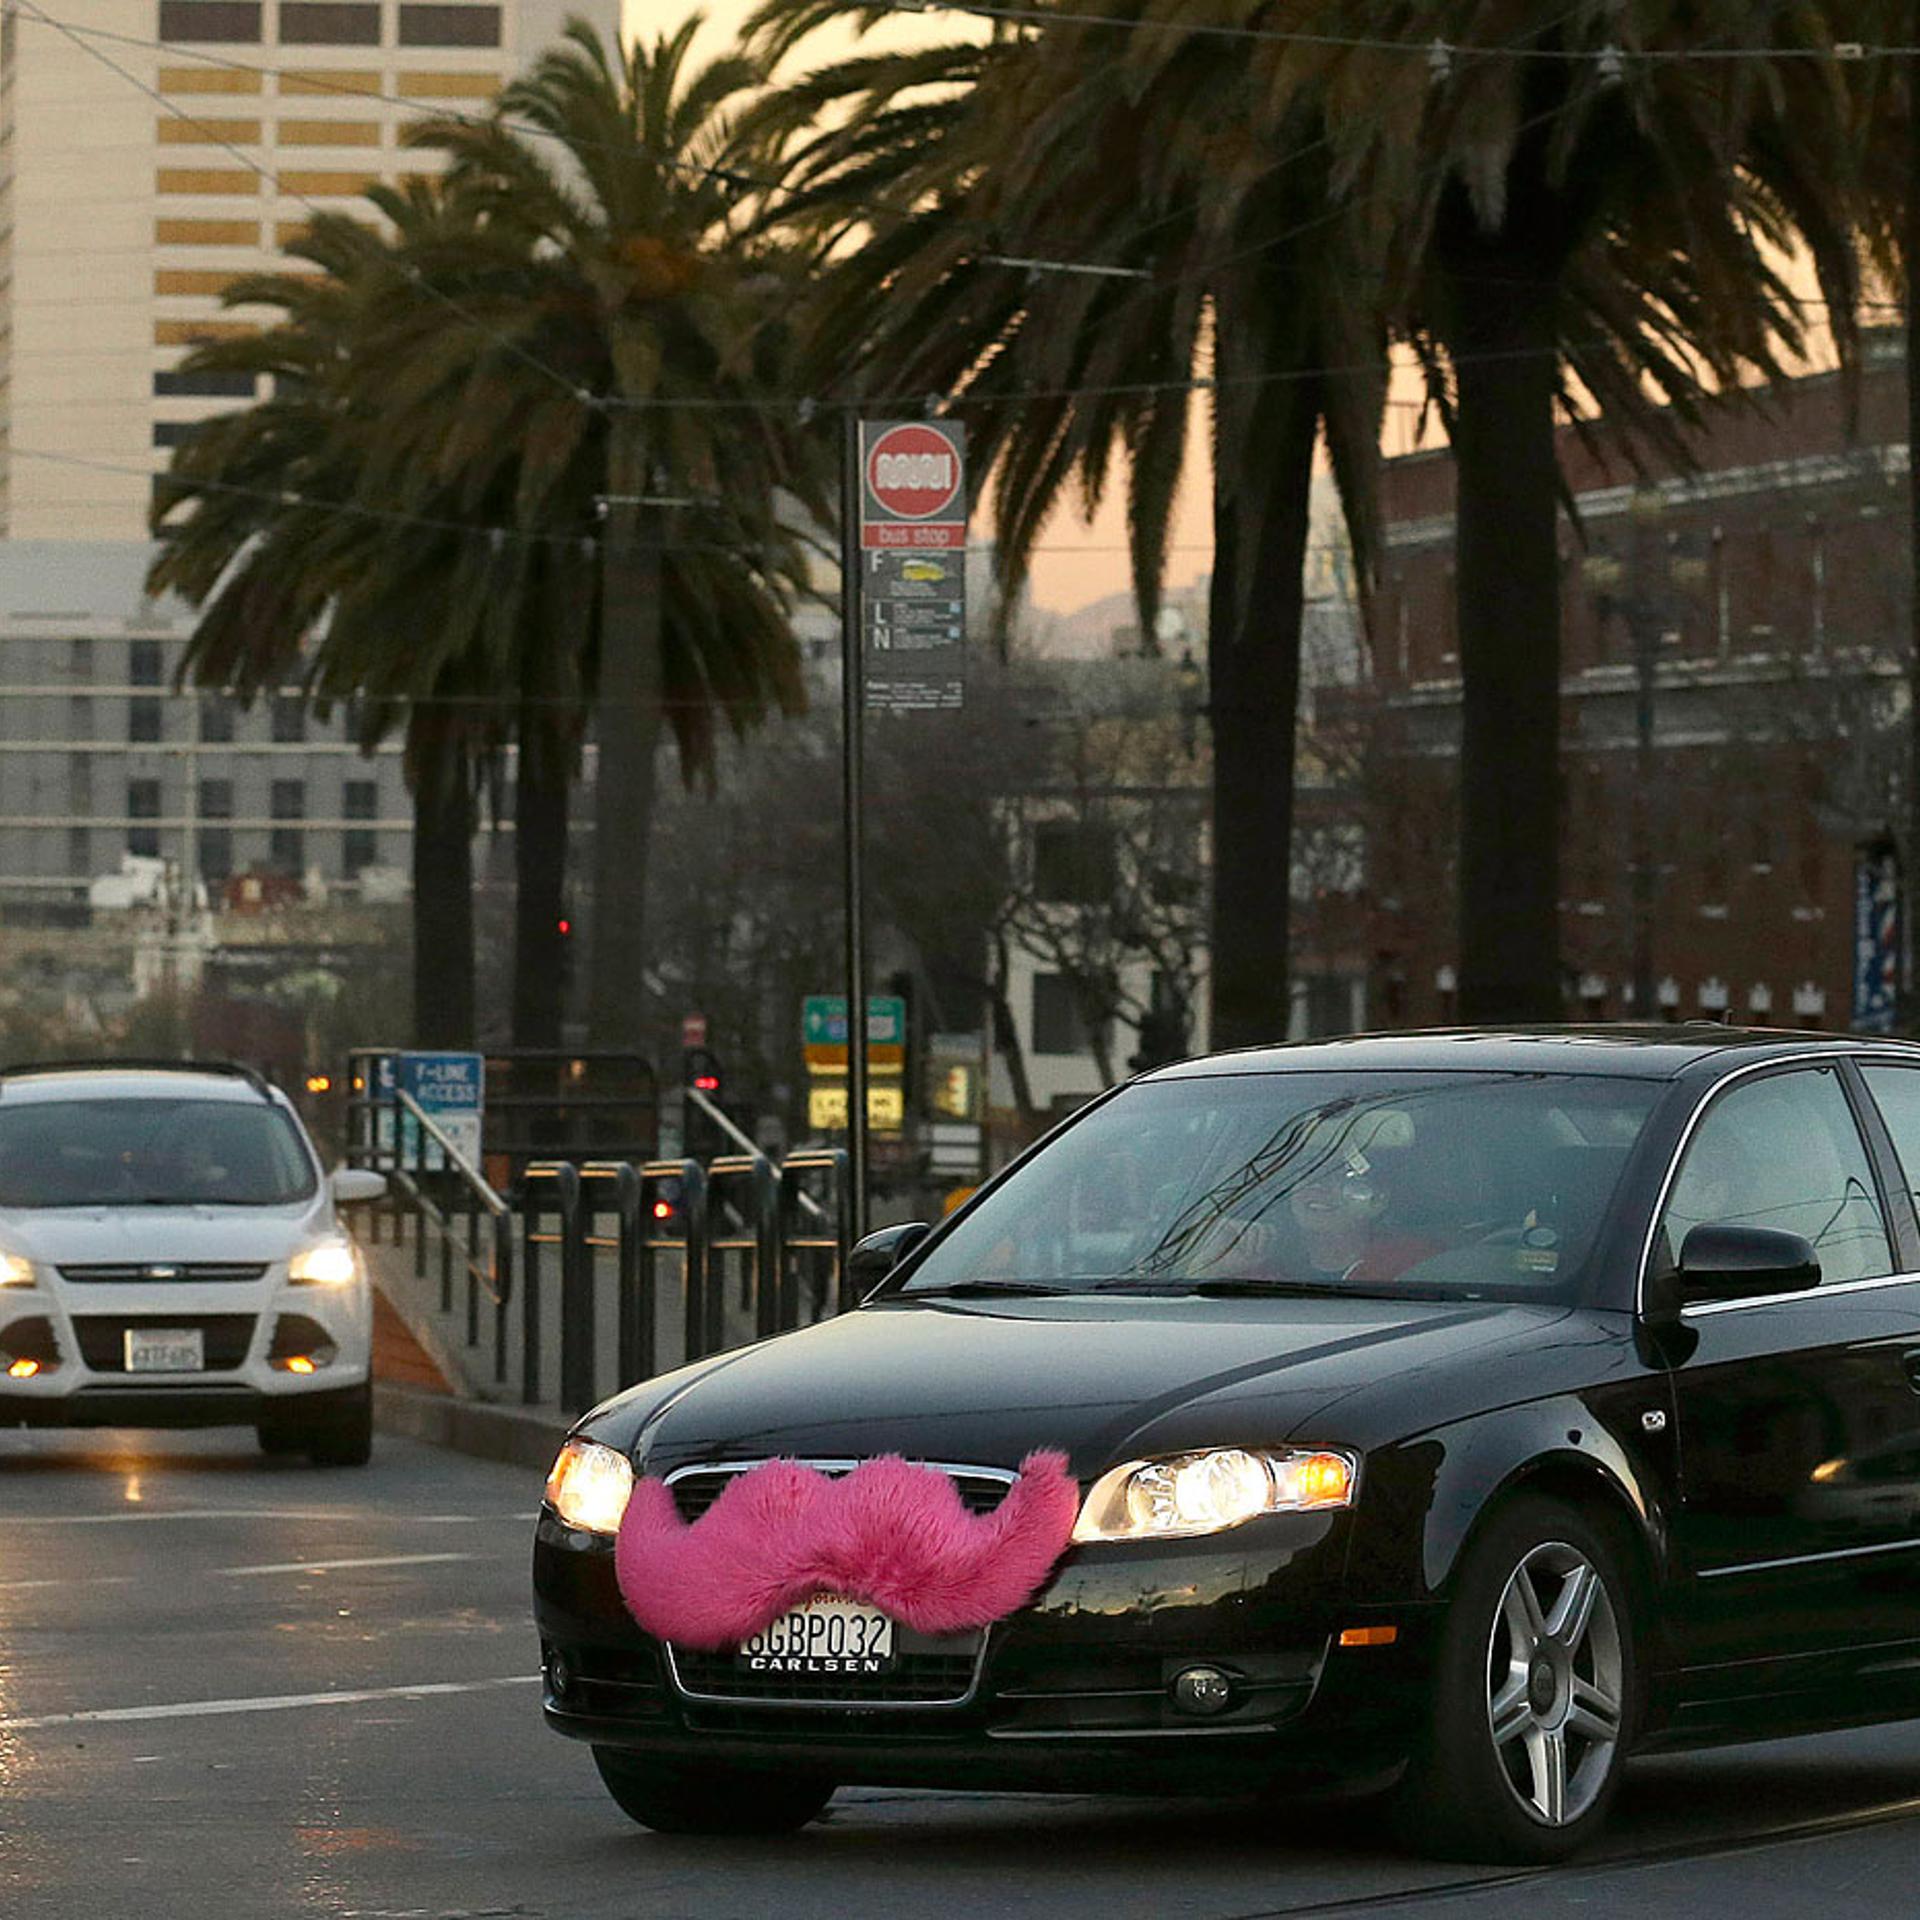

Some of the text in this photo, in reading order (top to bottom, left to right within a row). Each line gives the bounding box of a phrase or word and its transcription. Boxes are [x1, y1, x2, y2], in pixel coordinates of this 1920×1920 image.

[879, 526, 950, 545] bus stop
[871, 551, 883, 572] F
[875, 603, 887, 624] L
[873, 627, 890, 649] N
[417, 1083, 475, 1102] ACCESS
[750, 1657, 880, 1672] CARLSEN
